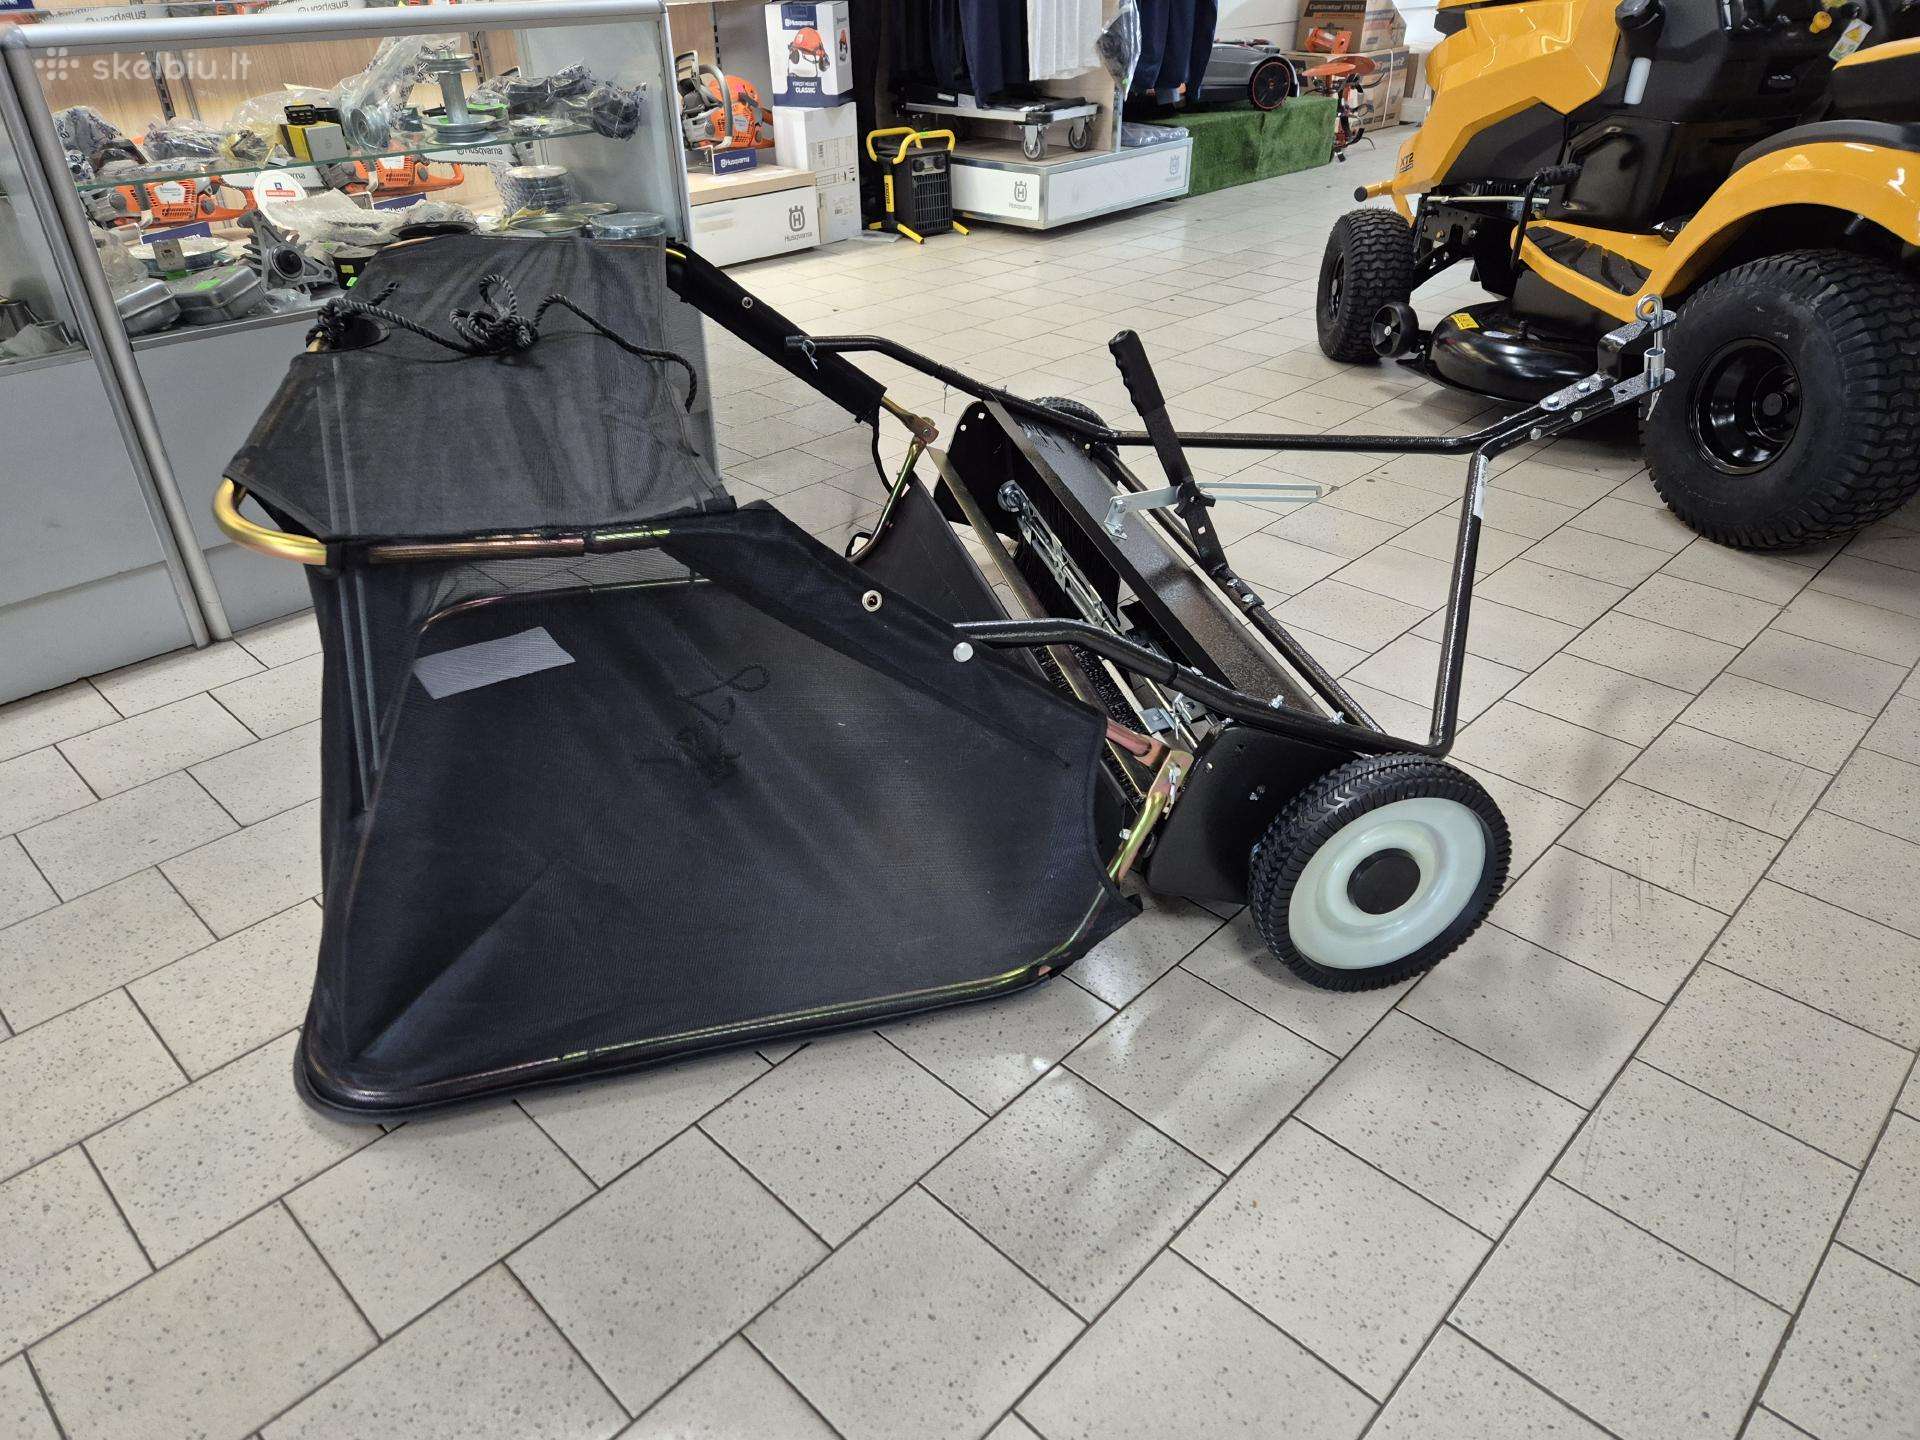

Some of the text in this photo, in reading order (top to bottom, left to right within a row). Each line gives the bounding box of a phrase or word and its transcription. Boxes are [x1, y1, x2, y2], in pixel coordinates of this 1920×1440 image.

[795, 86, 816, 94] CLASSIC
[725, 156, 750, 166] Husqvarna
[1400, 152, 1414, 168] XT2
[784, 231, 813, 243] Husqvarna
